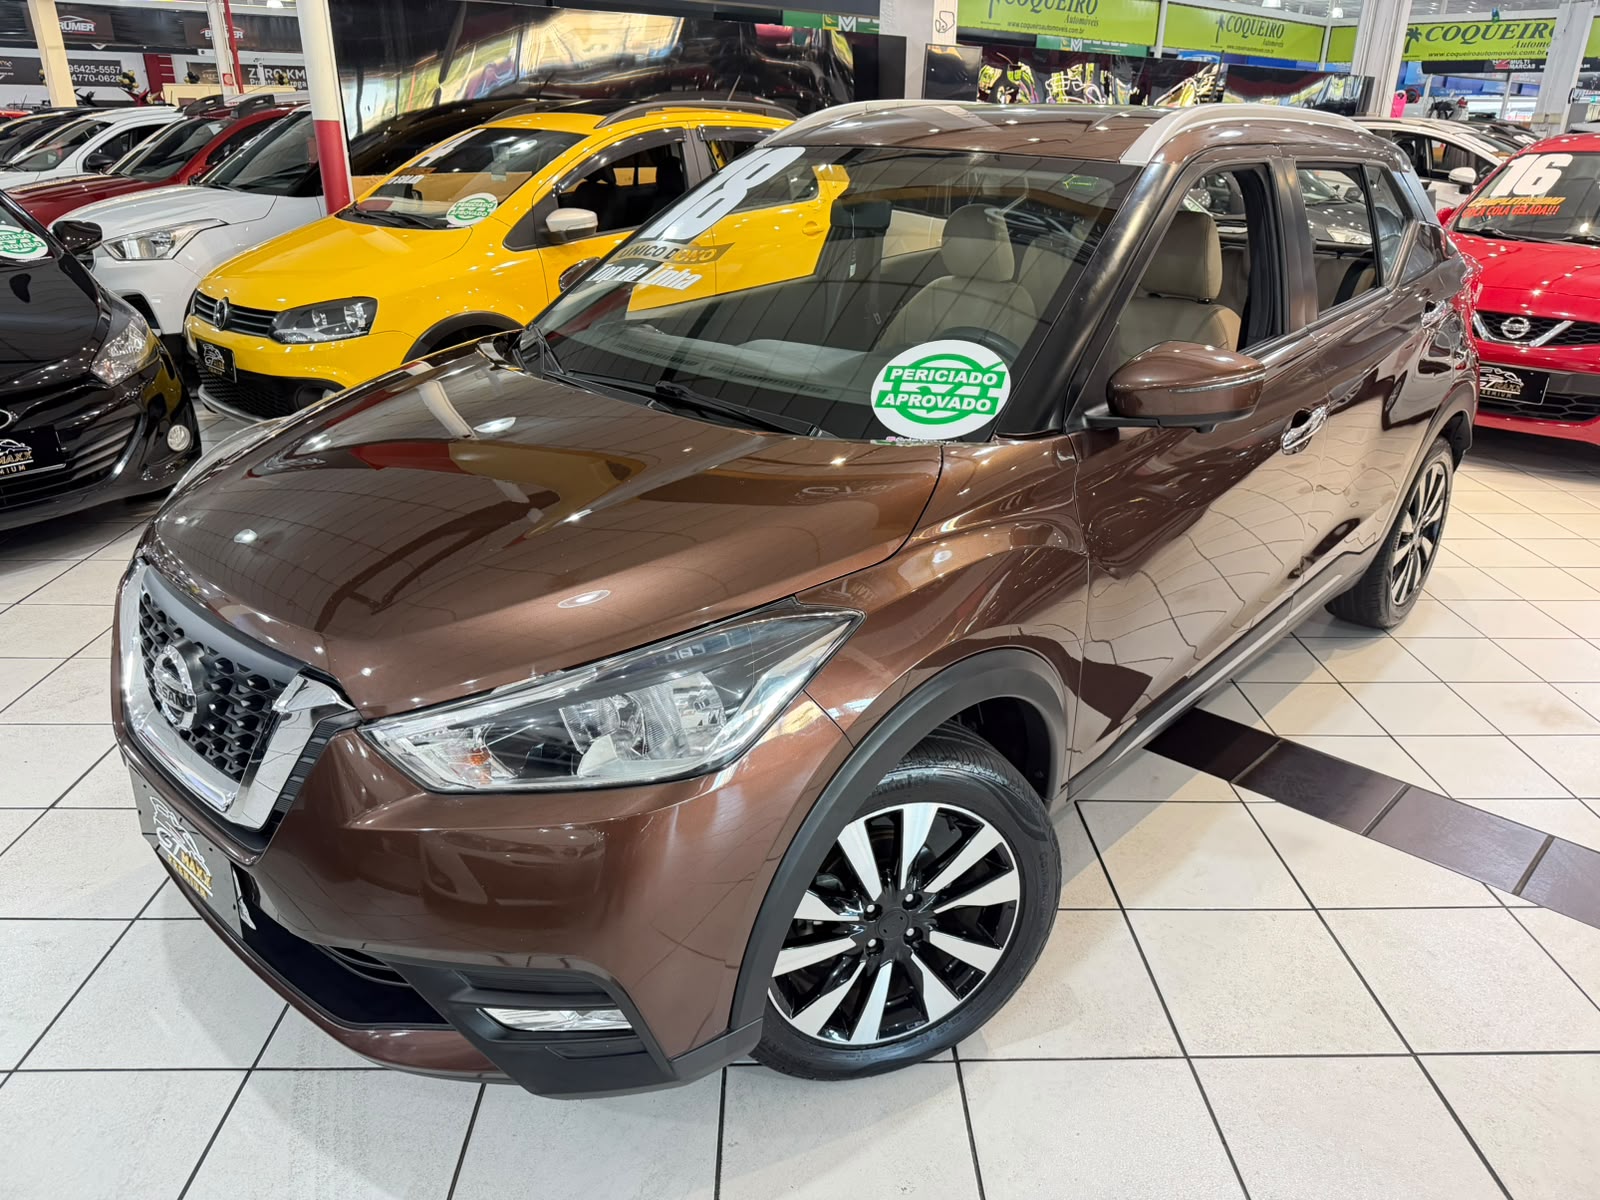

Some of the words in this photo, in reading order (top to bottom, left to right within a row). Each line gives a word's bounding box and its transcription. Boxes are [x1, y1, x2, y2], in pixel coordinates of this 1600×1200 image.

[1226, 16, 1285, 38] COQUEIRO
[286, 68, 306, 80] KM
[1490, 154, 1573, 196] 16
[1486, 205, 1510, 216] COLA
[1511, 204, 1561, 216] GELADA!!!
[890, 368, 998, 386] PERICIADO
[881, 393, 992, 412] APROVADO
